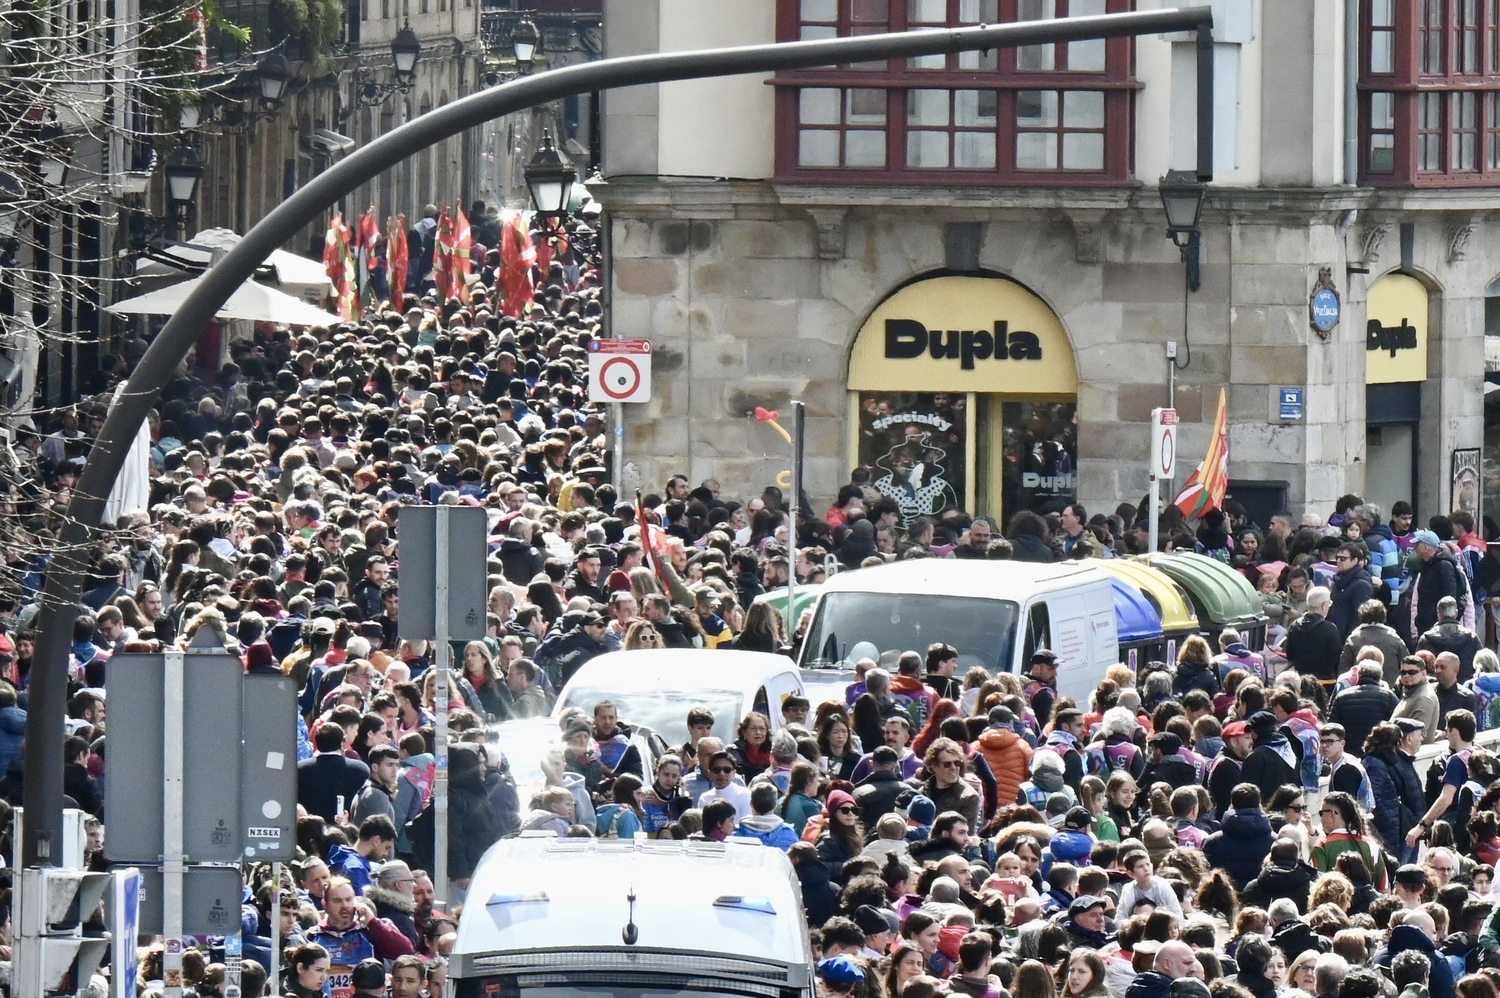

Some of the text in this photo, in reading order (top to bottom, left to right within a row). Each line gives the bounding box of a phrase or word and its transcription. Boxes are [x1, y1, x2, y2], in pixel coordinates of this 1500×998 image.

[885, 318, 1043, 370] Dupla
[1367, 317, 1418, 358] Dupla
[872, 411, 953, 432] specialty
[329, 973, 357, 989] 342
